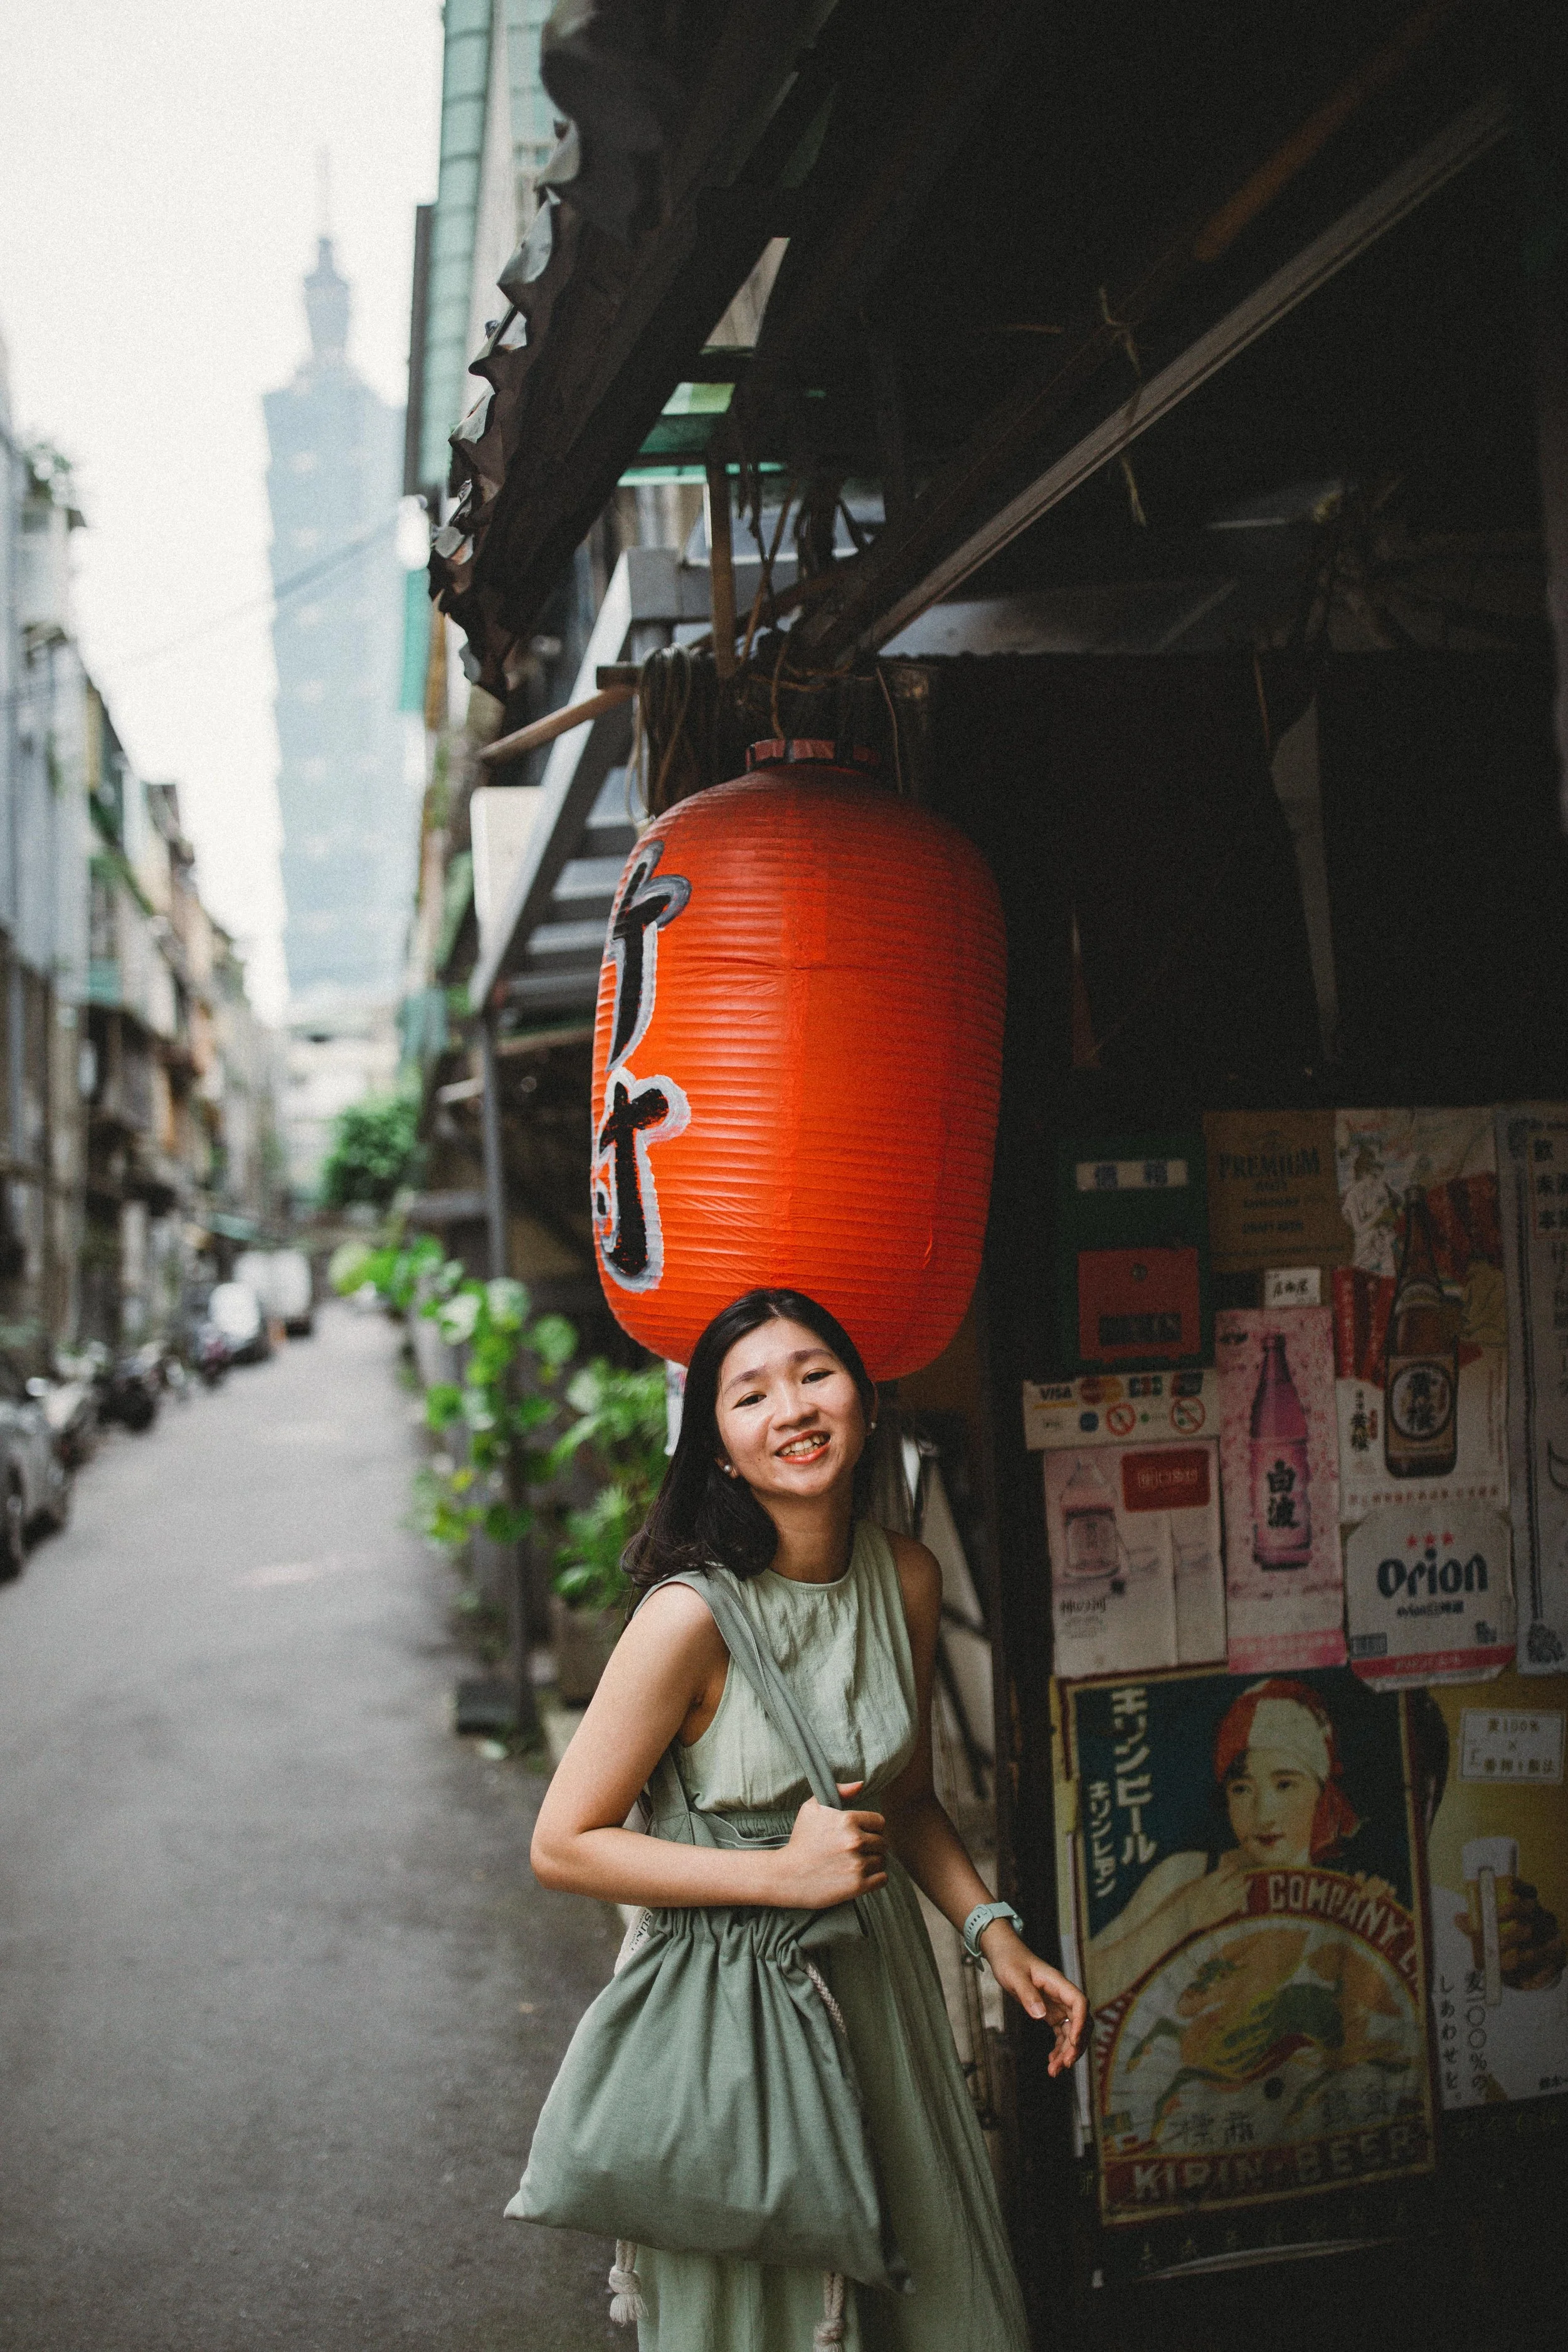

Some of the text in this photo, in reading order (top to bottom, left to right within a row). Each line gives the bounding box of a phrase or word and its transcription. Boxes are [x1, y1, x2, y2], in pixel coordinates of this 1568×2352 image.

[1219, 1147, 1320, 1179] PREMIUM
[1039, 1385, 1073, 1401] VISA
[1269, 1874, 1404, 1946] COMPANY
[1133, 2156, 1266, 2203] KIRIN
[1295, 2124, 1411, 2184] BEER
